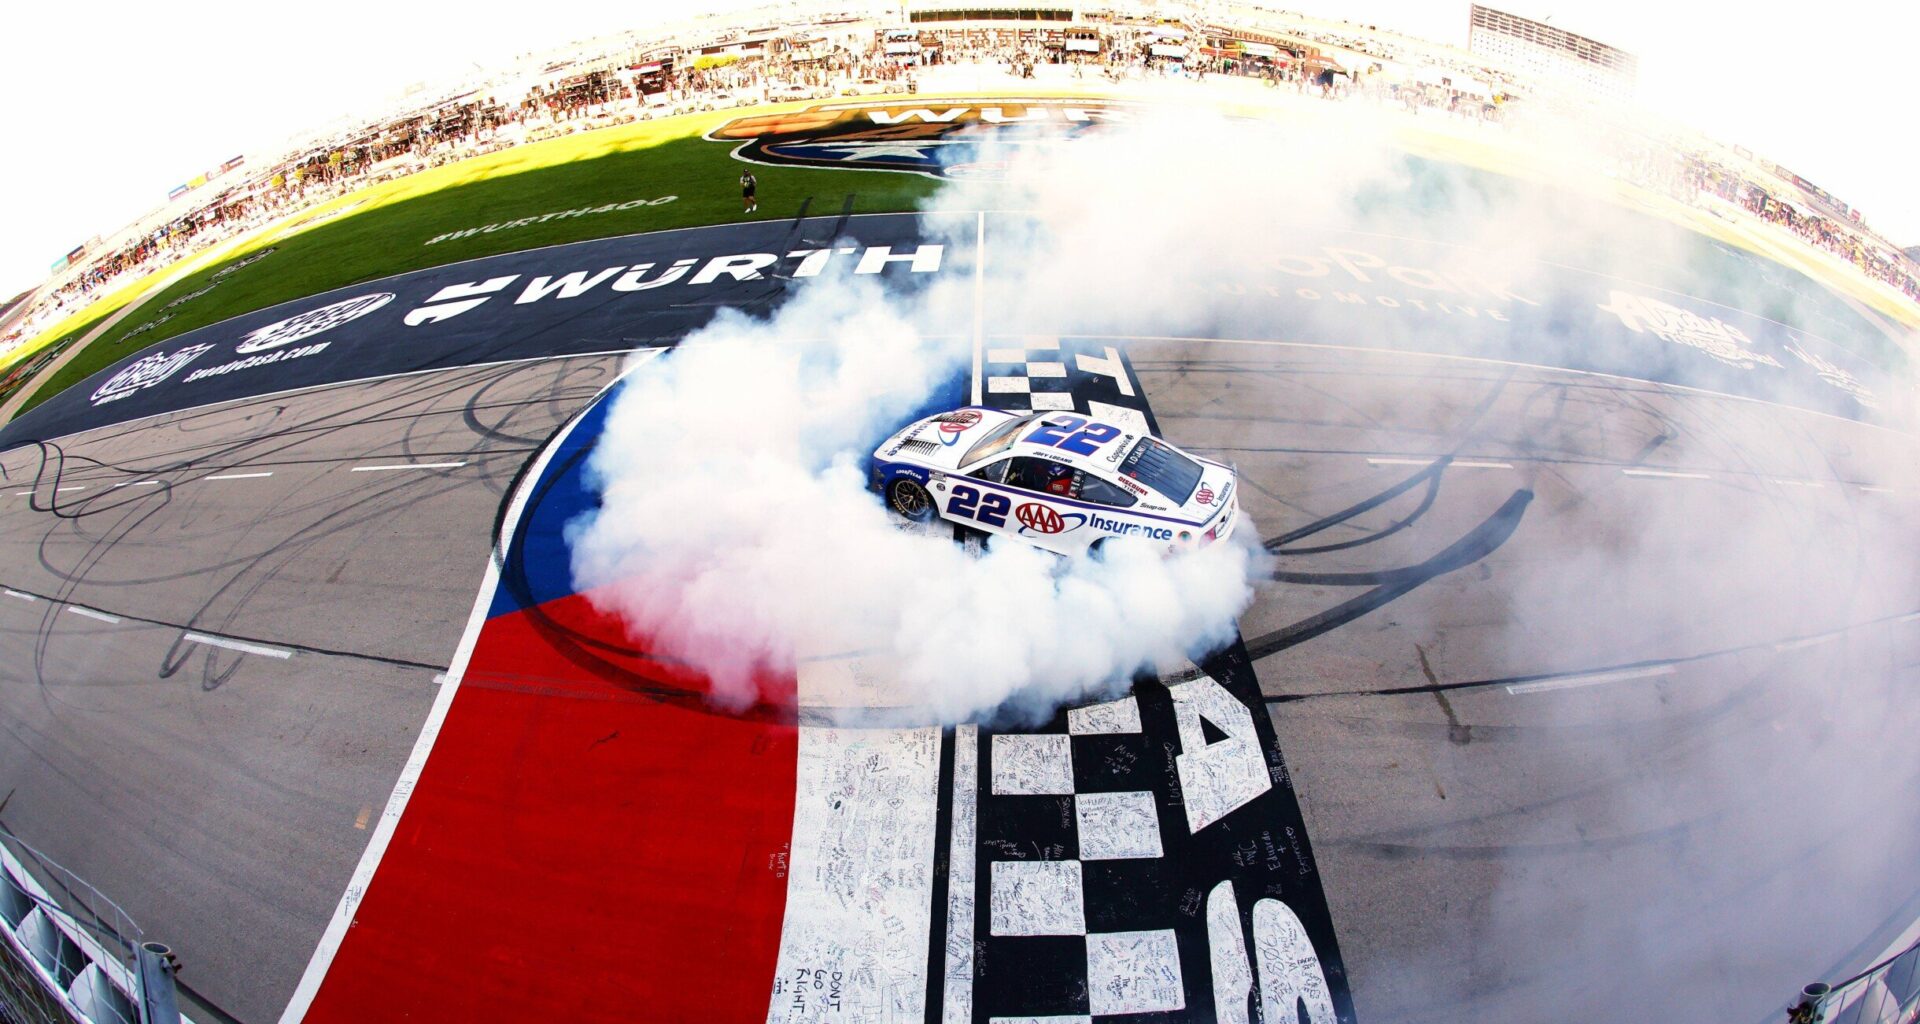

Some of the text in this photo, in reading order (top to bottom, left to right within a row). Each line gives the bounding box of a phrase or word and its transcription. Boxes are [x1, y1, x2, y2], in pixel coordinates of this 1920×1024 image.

[424, 195, 679, 246] #WURTH400
[1022, 415, 1122, 457] 22
[1033, 451, 1073, 464] JOEY LOGANO
[1118, 476, 1149, 497] DISCOUNT
[1123, 485, 1138, 495] TIRE
[946, 484, 1012, 529] 22
[1017, 503, 1062, 533] AAA
[1140, 502, 1167, 511] Snap-on
[1089, 513, 1173, 541] Insurance
[1261, 831, 1281, 871] Eduardo
[813, 969, 828, 990] GO
[829, 971, 843, 1012] DONT
